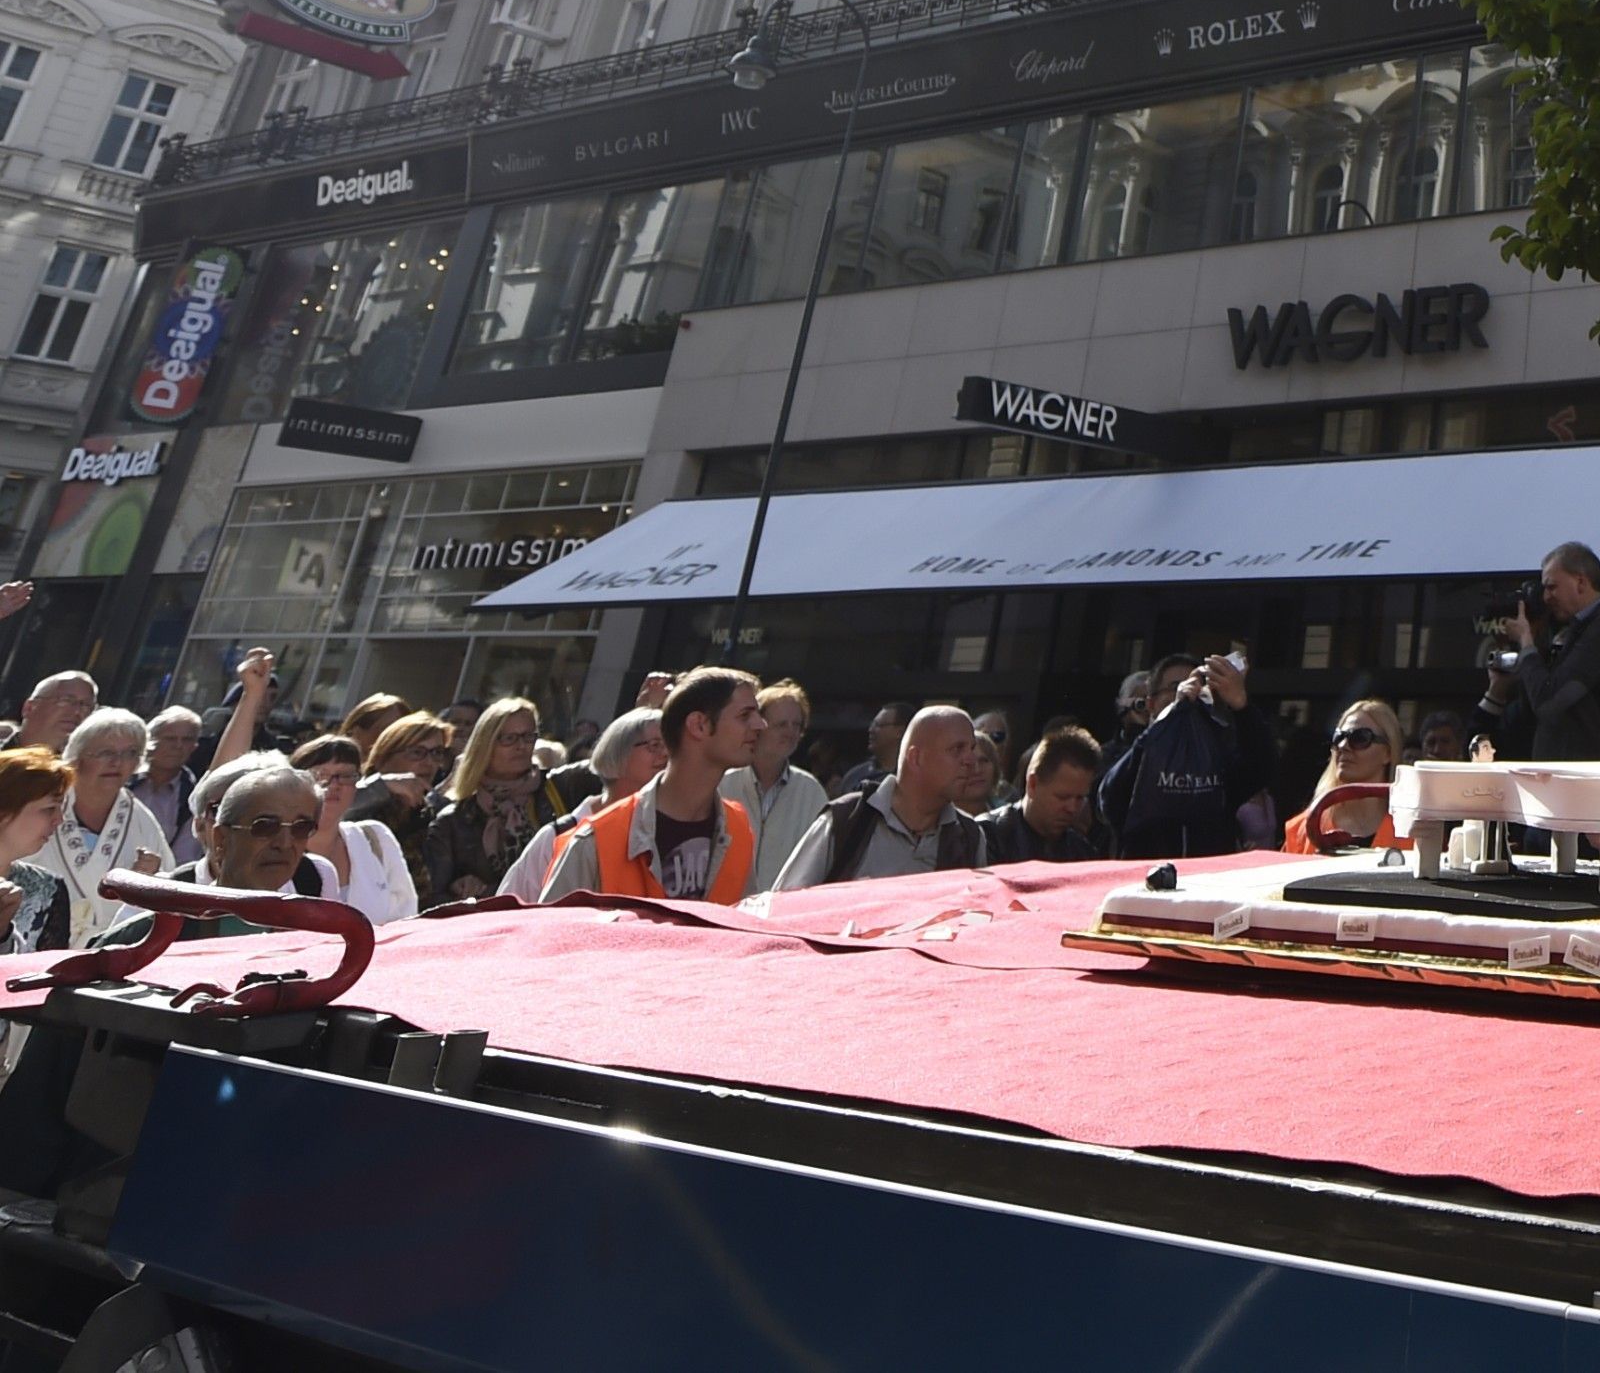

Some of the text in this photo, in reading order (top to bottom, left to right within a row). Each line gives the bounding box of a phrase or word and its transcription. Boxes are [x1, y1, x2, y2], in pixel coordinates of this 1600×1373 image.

[1188, 9, 1286, 51] ROLEX
[1009, 40, 1095, 84] Chopard
[721, 107, 761, 135] IWC
[574, 129, 669, 162] BVLGARI
[1227, 282, 1490, 370] WAGNER
[990, 380, 1118, 442] WAGNER
[288, 417, 410, 447] intimissimi
[410, 537, 591, 570] intimissim
[909, 555, 1006, 575] HOME
[1047, 548, 1223, 575] DIAMONDS
[1225, 552, 1287, 567] AND
[1296, 539, 1391, 563] TIME
[711, 627, 763, 645] WANER
